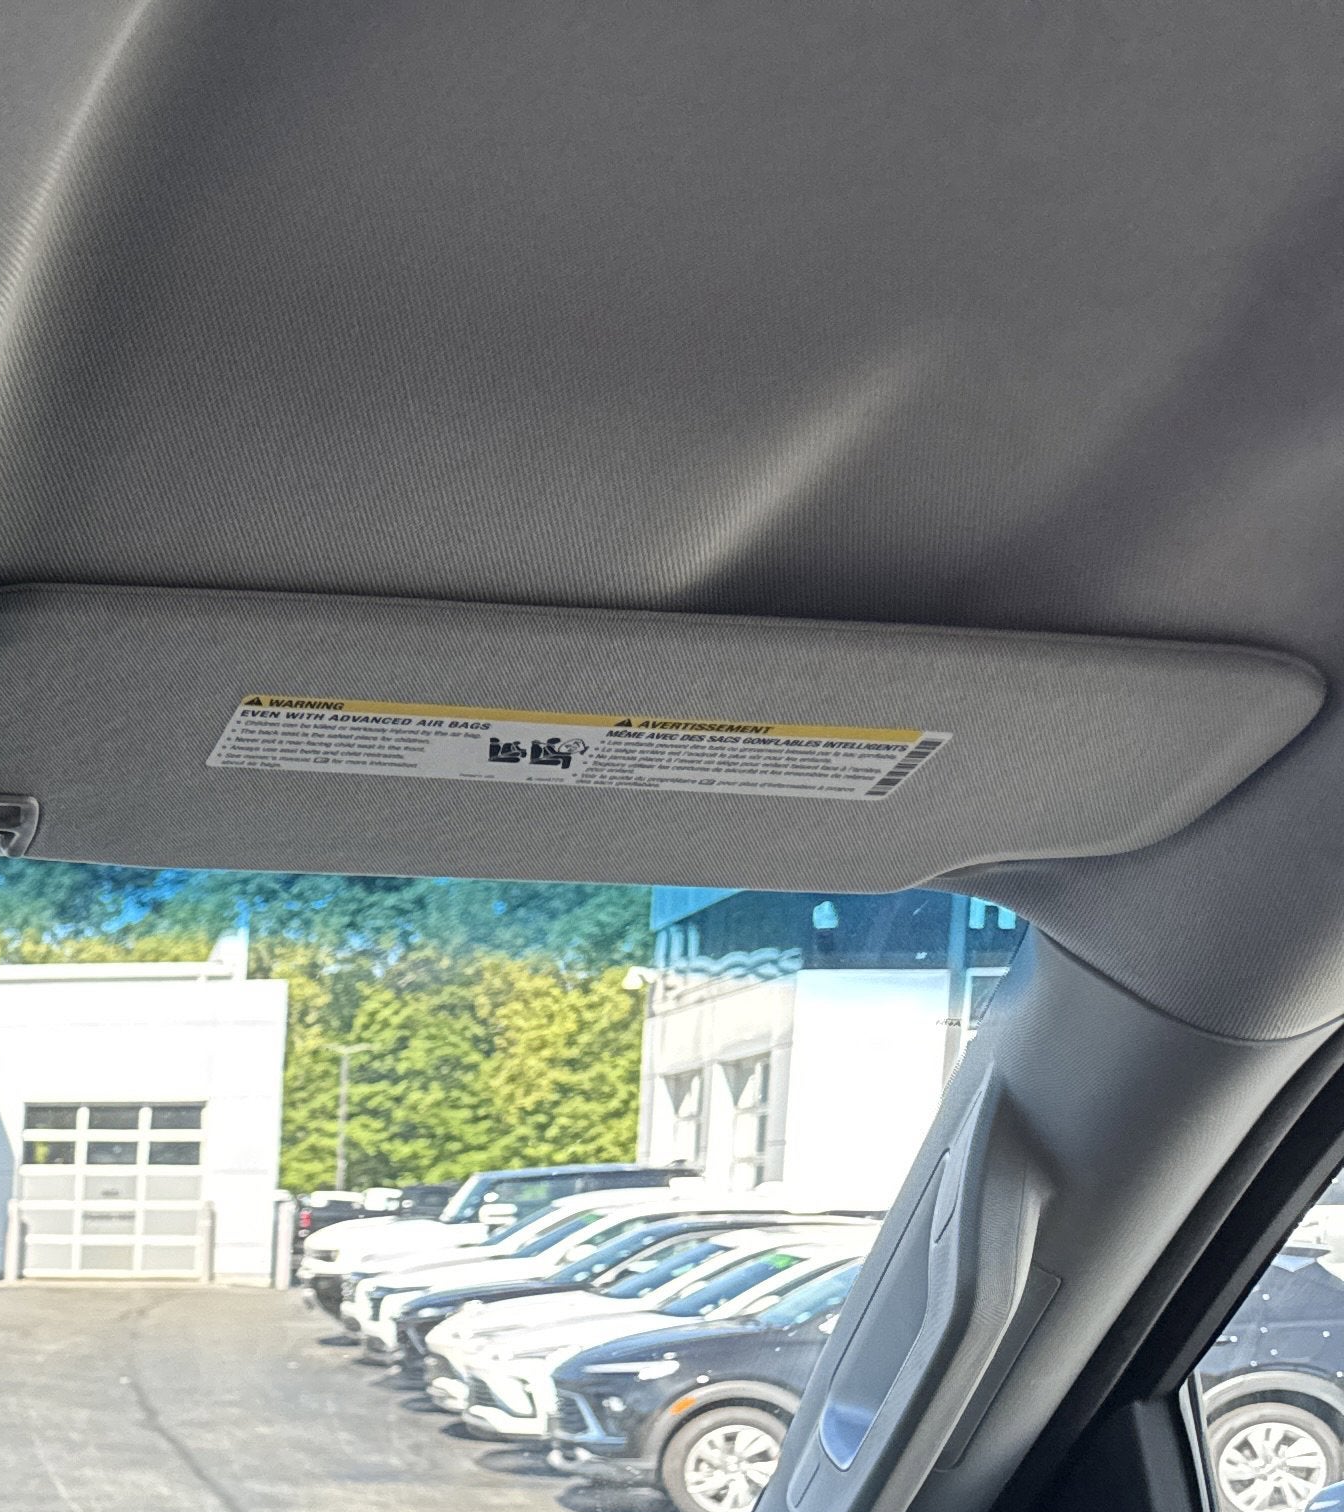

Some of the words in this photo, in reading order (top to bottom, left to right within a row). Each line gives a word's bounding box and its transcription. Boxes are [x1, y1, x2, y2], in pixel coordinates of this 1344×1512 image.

[269, 699, 344, 710] WARNING
[240, 710, 280, 718] EVEN
[286, 712, 324, 721] WITH
[328, 714, 412, 726] ADVANCED
[416, 718, 444, 728] AIR
[448, 720, 492, 730] BAGS
[638, 720, 774, 734] AVERTISSEMENT
[606, 730, 645, 738] MÊME
[646, 732, 678, 741] AVEC
[709, 735, 741, 744] SACS
[743, 737, 822, 748] GONFLABLES
[823, 741, 909, 751] INTELLIGENTS
